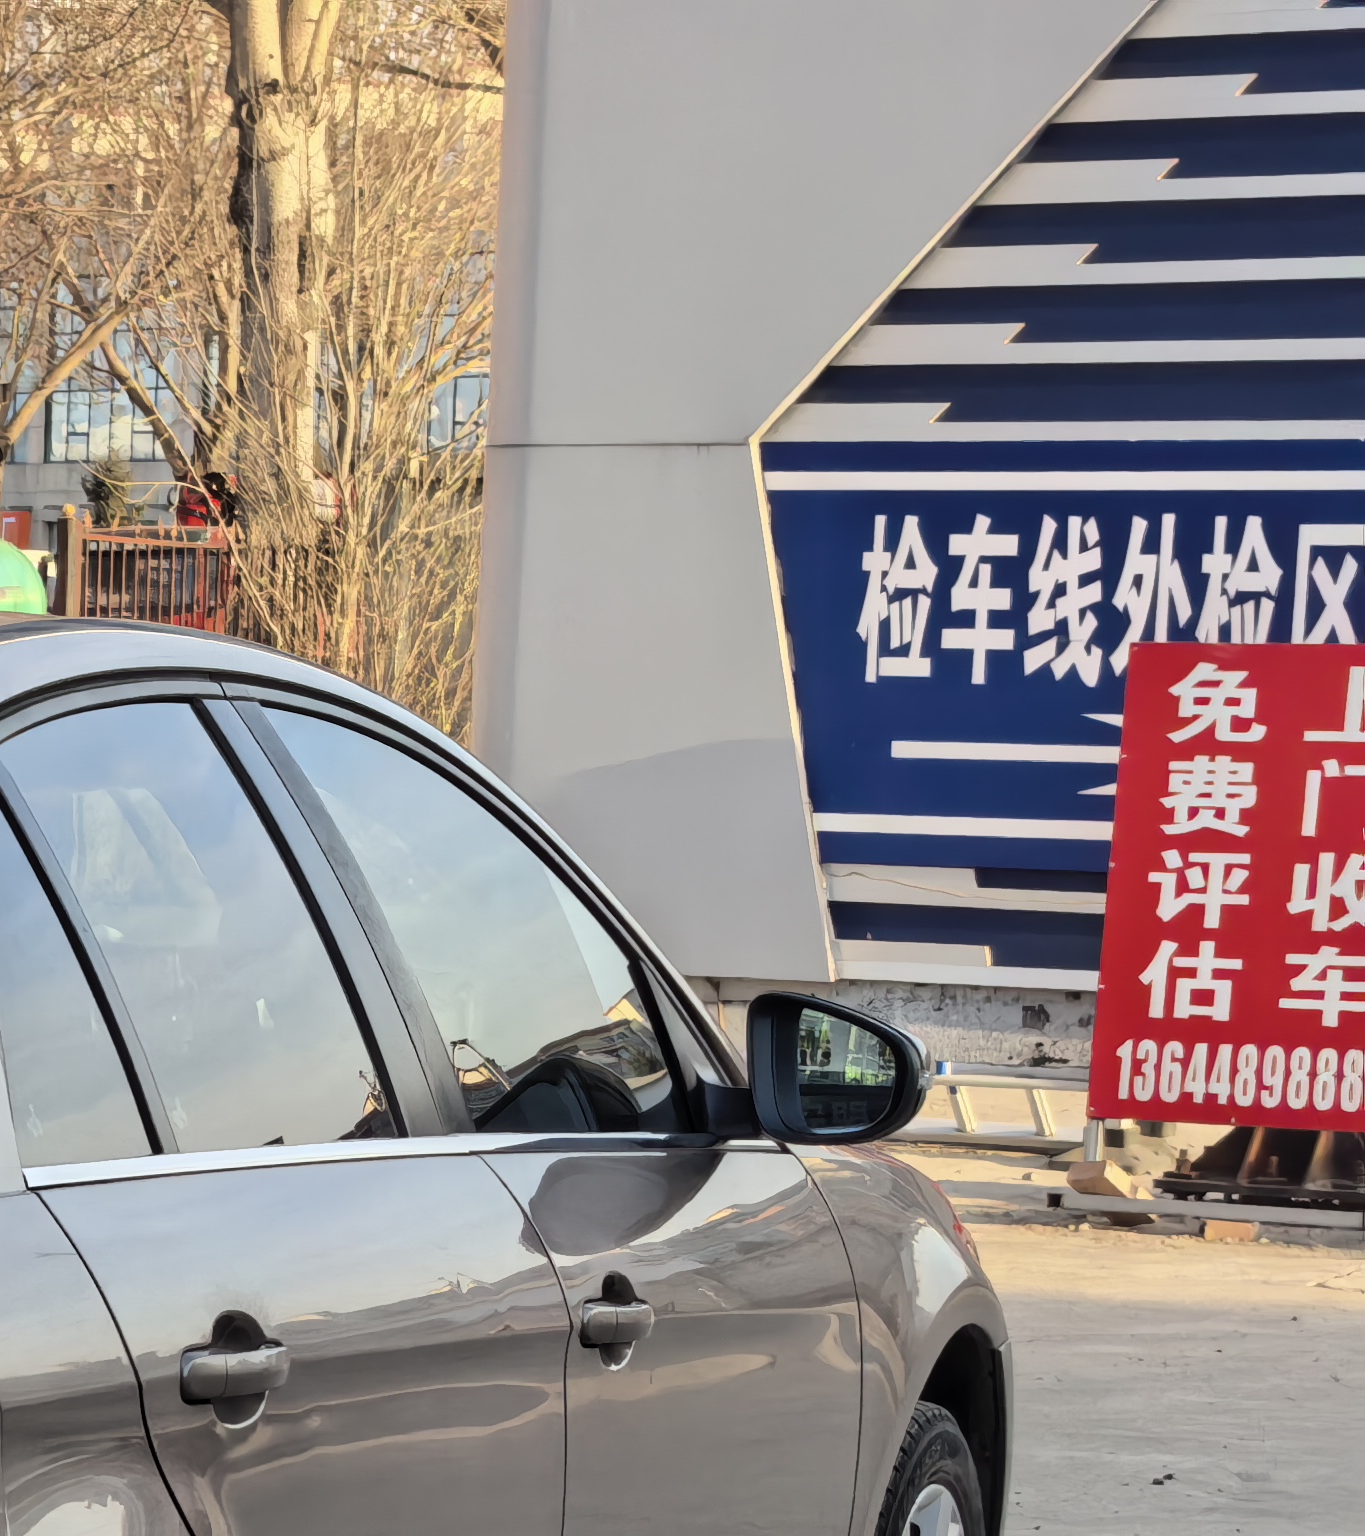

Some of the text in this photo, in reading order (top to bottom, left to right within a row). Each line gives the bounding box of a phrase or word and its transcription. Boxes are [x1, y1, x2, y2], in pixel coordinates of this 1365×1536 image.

[855, 512, 1365, 687] 检车线外检区
[1137, 661, 1268, 1023] 免费评估
